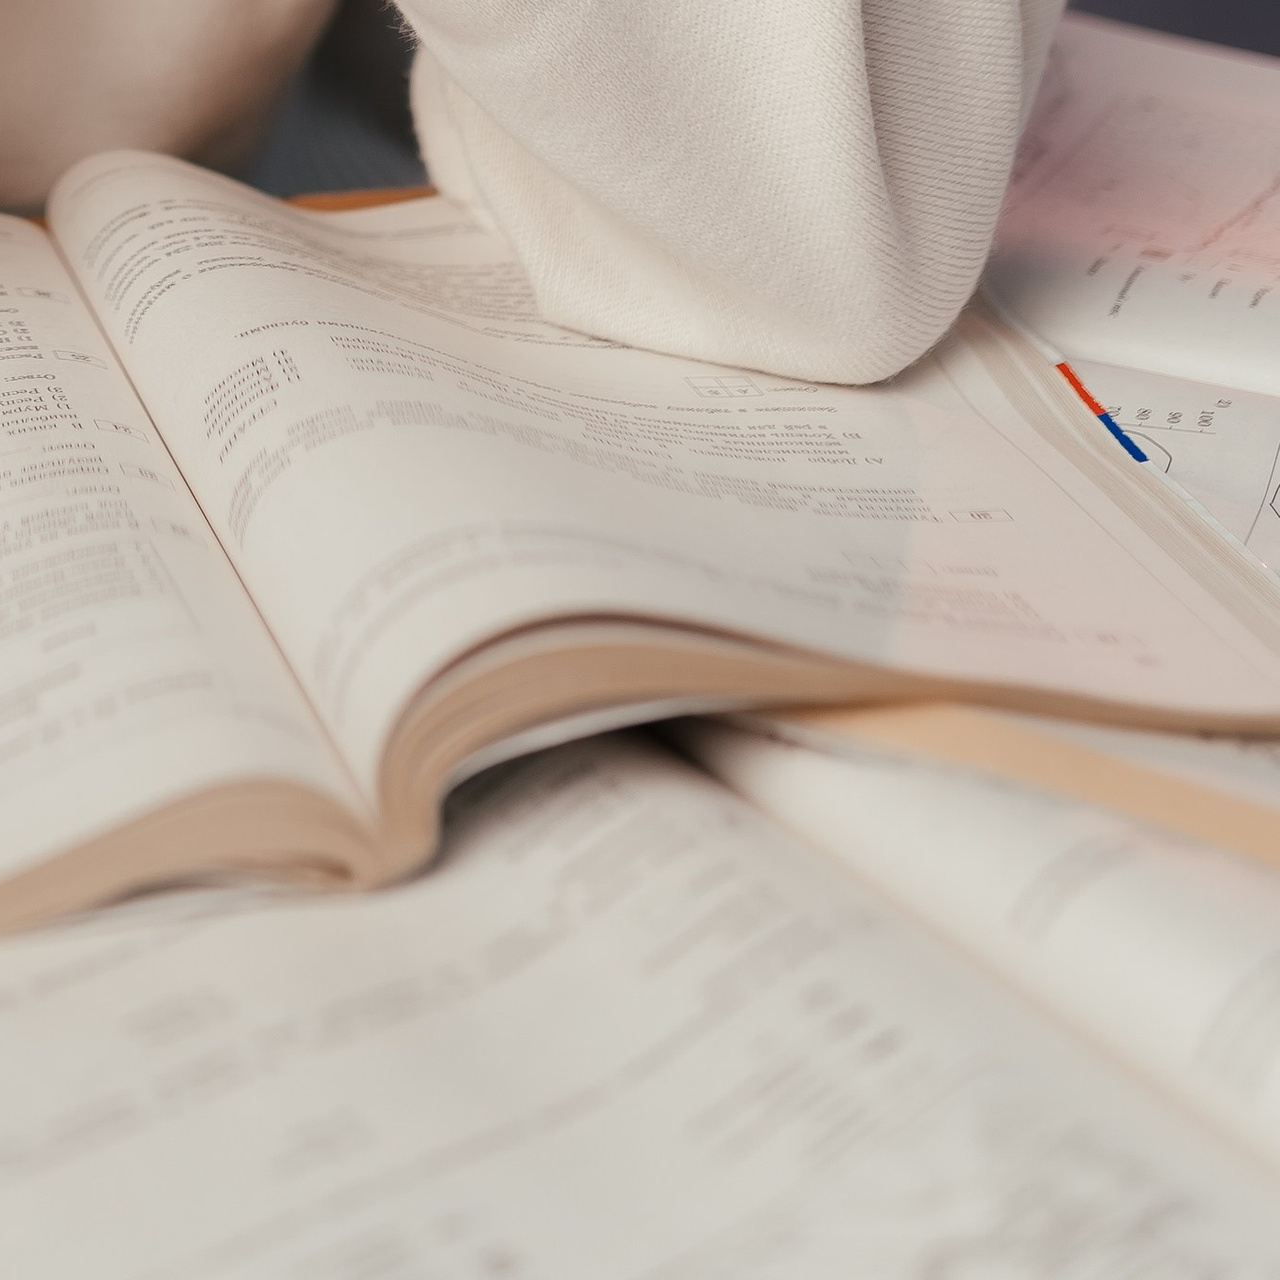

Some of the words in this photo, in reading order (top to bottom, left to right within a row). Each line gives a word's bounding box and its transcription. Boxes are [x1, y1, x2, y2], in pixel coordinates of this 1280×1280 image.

[4, 373, 56, 383] Ответ:
[47, 386, 63, 394] 3)
[51, 394, 67, 402] 2)
[1166, 410, 1183, 425] 90
[1197, 410, 1215, 427] 100
[7, 424, 57, 435] каких
